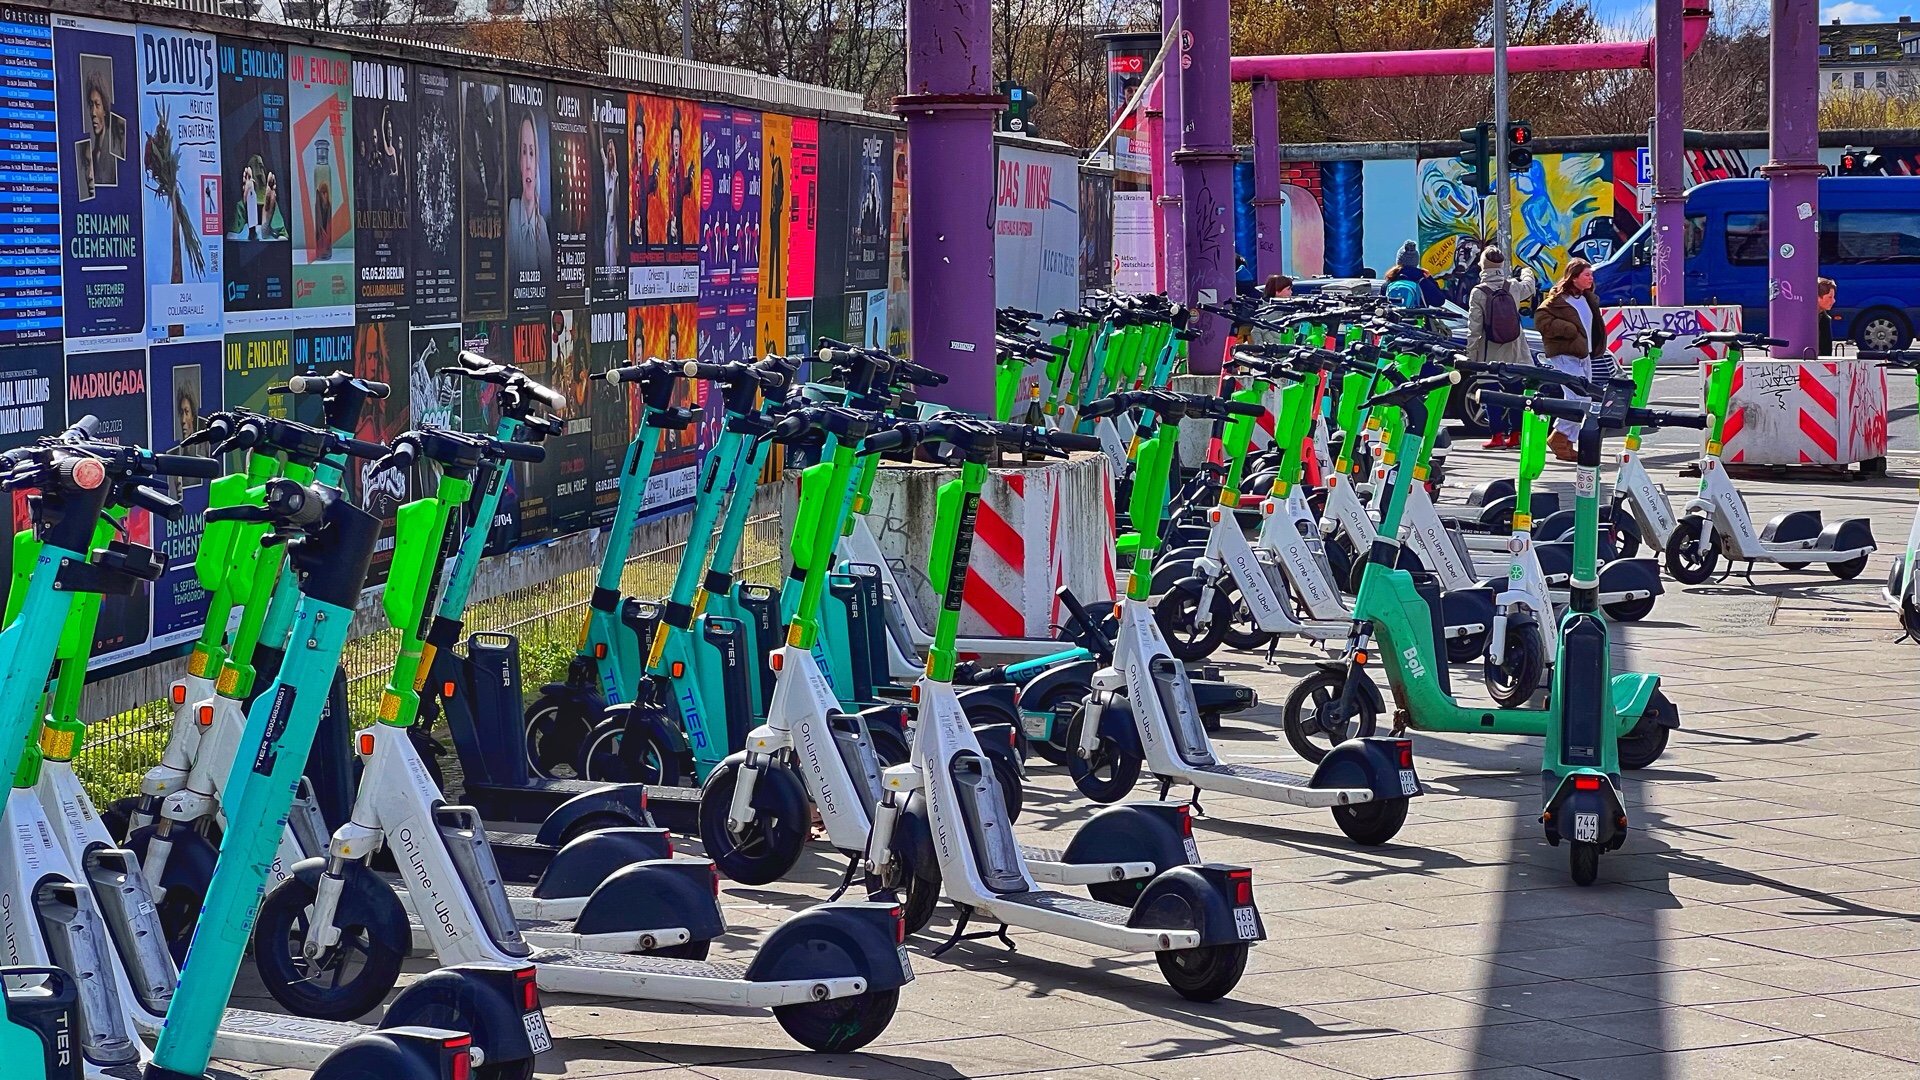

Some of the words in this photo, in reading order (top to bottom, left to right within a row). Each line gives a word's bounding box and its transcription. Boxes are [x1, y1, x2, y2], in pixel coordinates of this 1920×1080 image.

[4, 8, 50, 25] GRETCHEN
[143, 33, 214, 91] DONOTS
[352, 60, 384, 100] MONO
[387, 64, 408, 102] INC.
[509, 84, 526, 104] TINA
[526, 86, 542, 107] DICO
[556, 95, 580, 118] QUEEN
[1130, 140, 1150, 150] NOTHI
[998, 160, 1019, 208] DAS
[1024, 164, 1052, 210] MINSK
[76, 214, 130, 235] BENJAMIN
[71, 237, 136, 259] CLEMENTINE
[362, 266, 386, 281] 05.05.23
[386, 266, 405, 280] BERLIN
[88, 296, 124, 309] TEMPODROM
[94, 284, 124, 296] SEPTEMBER
[362, 284, 404, 296] COLUMBIAHALLE
[850, 296, 862, 312] ARIEL
[590, 312, 612, 344] MONO
[614, 312, 628, 341] INC.
[848, 312, 863, 327] POSEN
[514, 323, 546, 364] MELVINS
[15, 377, 50, 405] WILLIAMS
[70, 369, 145, 400] MADRUGADA
[20, 405, 44, 432] OMORI
[1642, 486, 1650, 498] On
[1648, 497, 1658, 511] Lime
[1658, 516, 1668, 531] Uber
[1725, 492, 1732, 505] On
[1731, 503, 1740, 518] Lime
[1740, 522, 1750, 538] Uber
[1350, 512, 1358, 522] On
[1356, 521, 1366, 539] Lime
[161, 534, 203, 560] CLEMENT
[1427, 528, 1436, 540] On
[1433, 539, 1444, 556] Lime
[1445, 560, 1458, 578] Uber
[1236, 556, 1246, 570] On
[1243, 569, 1256, 588] Lime
[1257, 593, 1271, 613] Uber
[1290, 546, 1298, 560] On
[1295, 559, 1308, 577] Lime
[1308, 582, 1321, 601] Uber
[1130, 664, 1138, 684] On
[1403, 646, 1426, 678] Bolt
[1132, 684, 1142, 708] Lime
[680, 688, 707, 750] TIER
[1142, 714, 1154, 743] Uber
[256, 740, 268, 768] TIER
[802, 722, 810, 742] On
[808, 742, 821, 773] Lime
[821, 784, 837, 815] Uber
[928, 758, 934, 778] On
[930, 779, 939, 812] Lime
[1577, 829, 1596, 840] MLZ
[1578, 816, 1595, 827] 744
[938, 826, 949, 859] Uber
[400, 828, 413, 852] On
[409, 852, 432, 889] Lime
[434, 900, 457, 938] Uber
[2, 894, 10, 920] On
[1236, 910, 1252, 922] 463
[4, 921, 18, 966] Lime
[525, 1015, 542, 1033] 355
[56, 1011, 70, 1067] TIER
